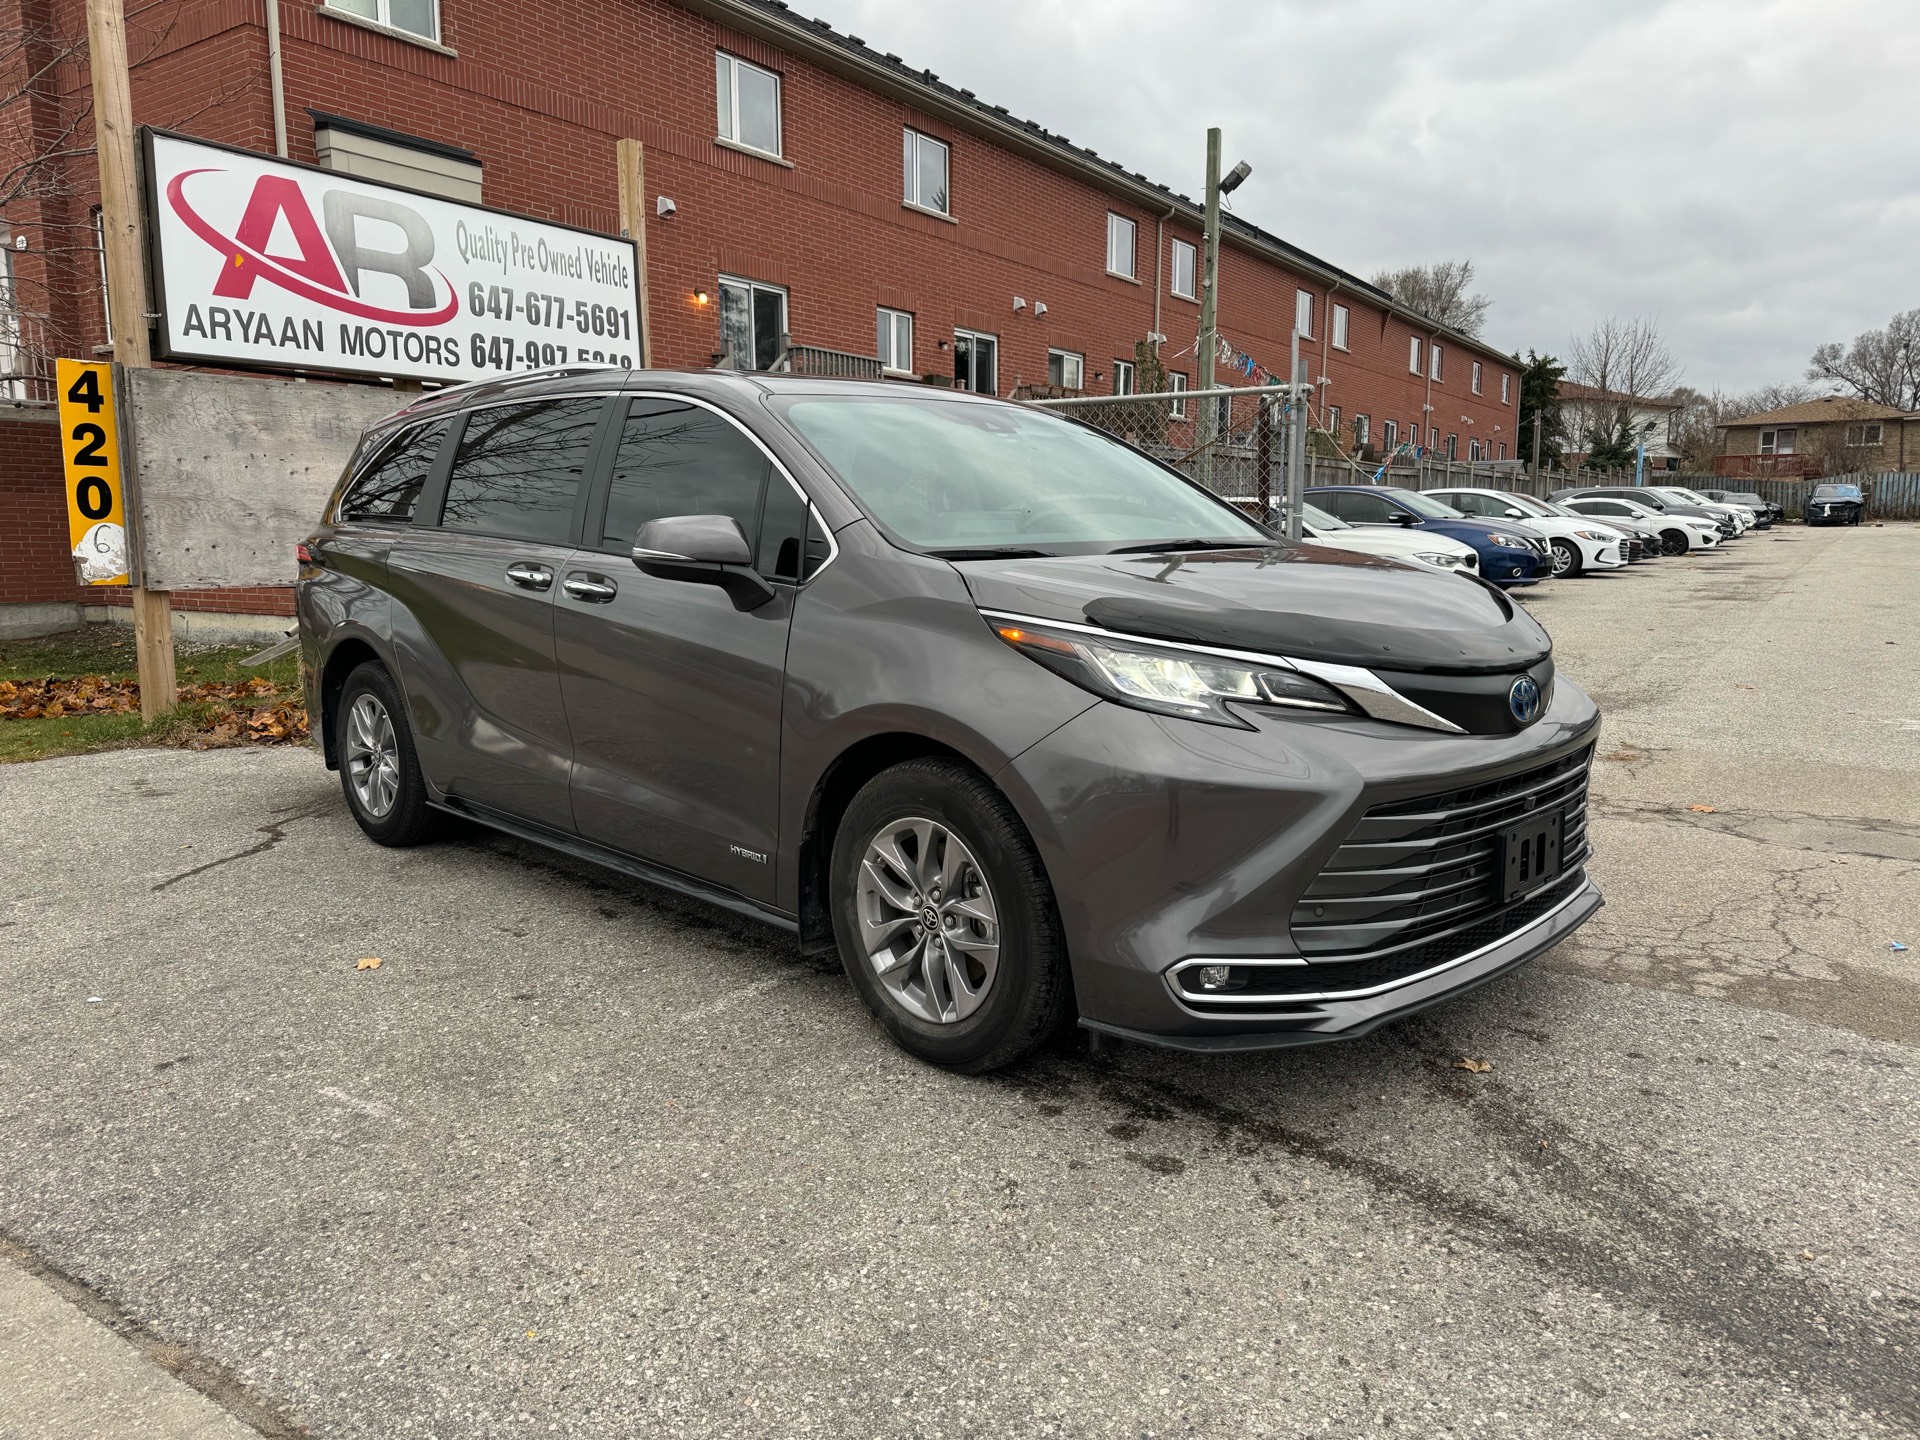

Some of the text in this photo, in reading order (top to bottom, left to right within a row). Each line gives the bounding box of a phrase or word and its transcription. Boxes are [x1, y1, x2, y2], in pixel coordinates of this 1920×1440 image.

[456, 219, 629, 290] Quality Pre Owned Vehicle
[182, 303, 461, 368] ARYAAN MOTORS
[468, 281, 631, 341] 647-677-5691
[67, 370, 113, 521] 420
[730, 844, 761, 862] HYBRID
